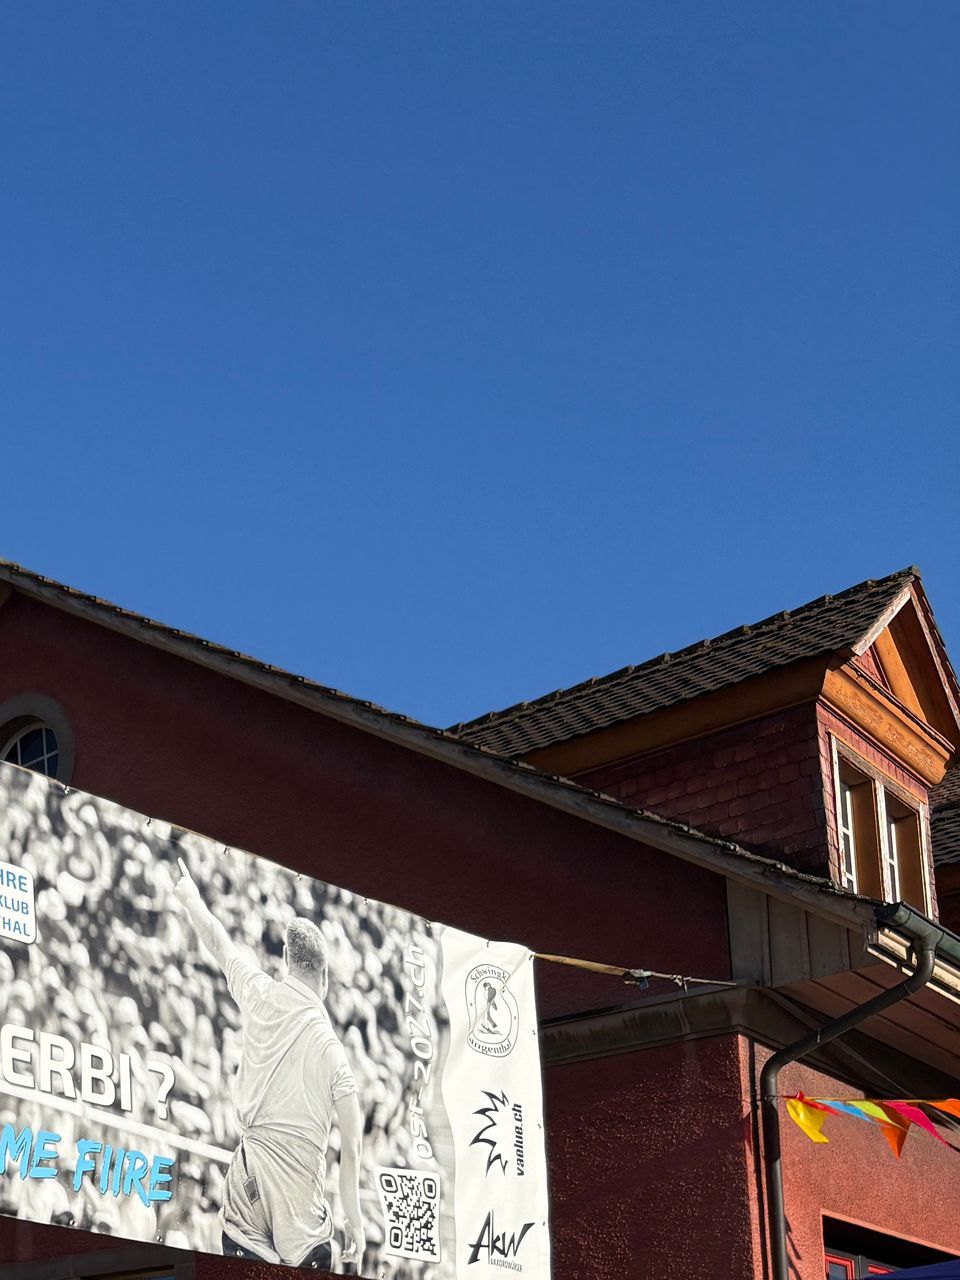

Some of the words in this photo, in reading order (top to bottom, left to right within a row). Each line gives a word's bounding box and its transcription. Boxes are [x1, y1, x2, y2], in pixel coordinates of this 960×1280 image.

[405, 944, 433, 1160] osf-2027.ch
[72, 1138, 174, 1208] FIIRE
[512, 1103, 525, 1176] vaelue.ch
